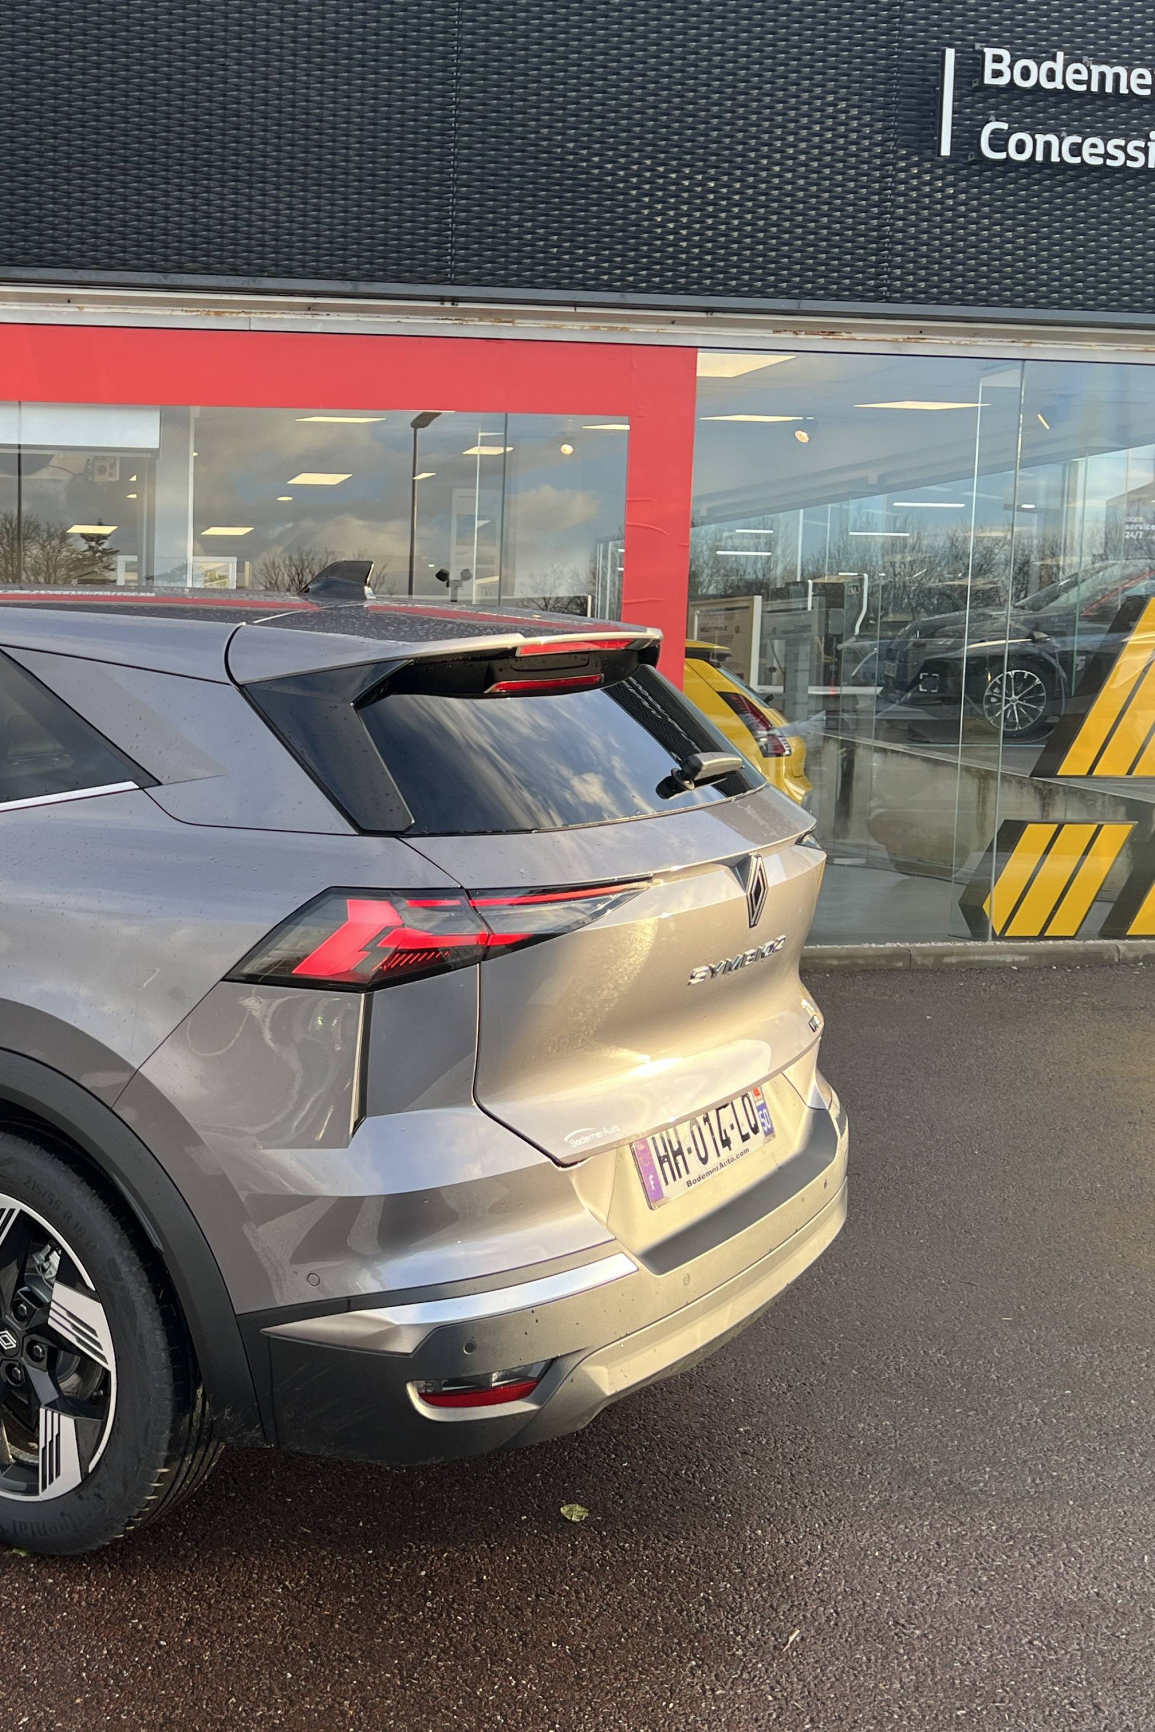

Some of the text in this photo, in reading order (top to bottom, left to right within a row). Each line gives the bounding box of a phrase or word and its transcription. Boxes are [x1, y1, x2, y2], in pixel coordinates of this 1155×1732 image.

[983, 47, 1155, 96] Bodeme
[1124, 530, 1144, 540] 24/7
[758, 1108, 772, 1134] 50
[649, 1173, 657, 1191] F
